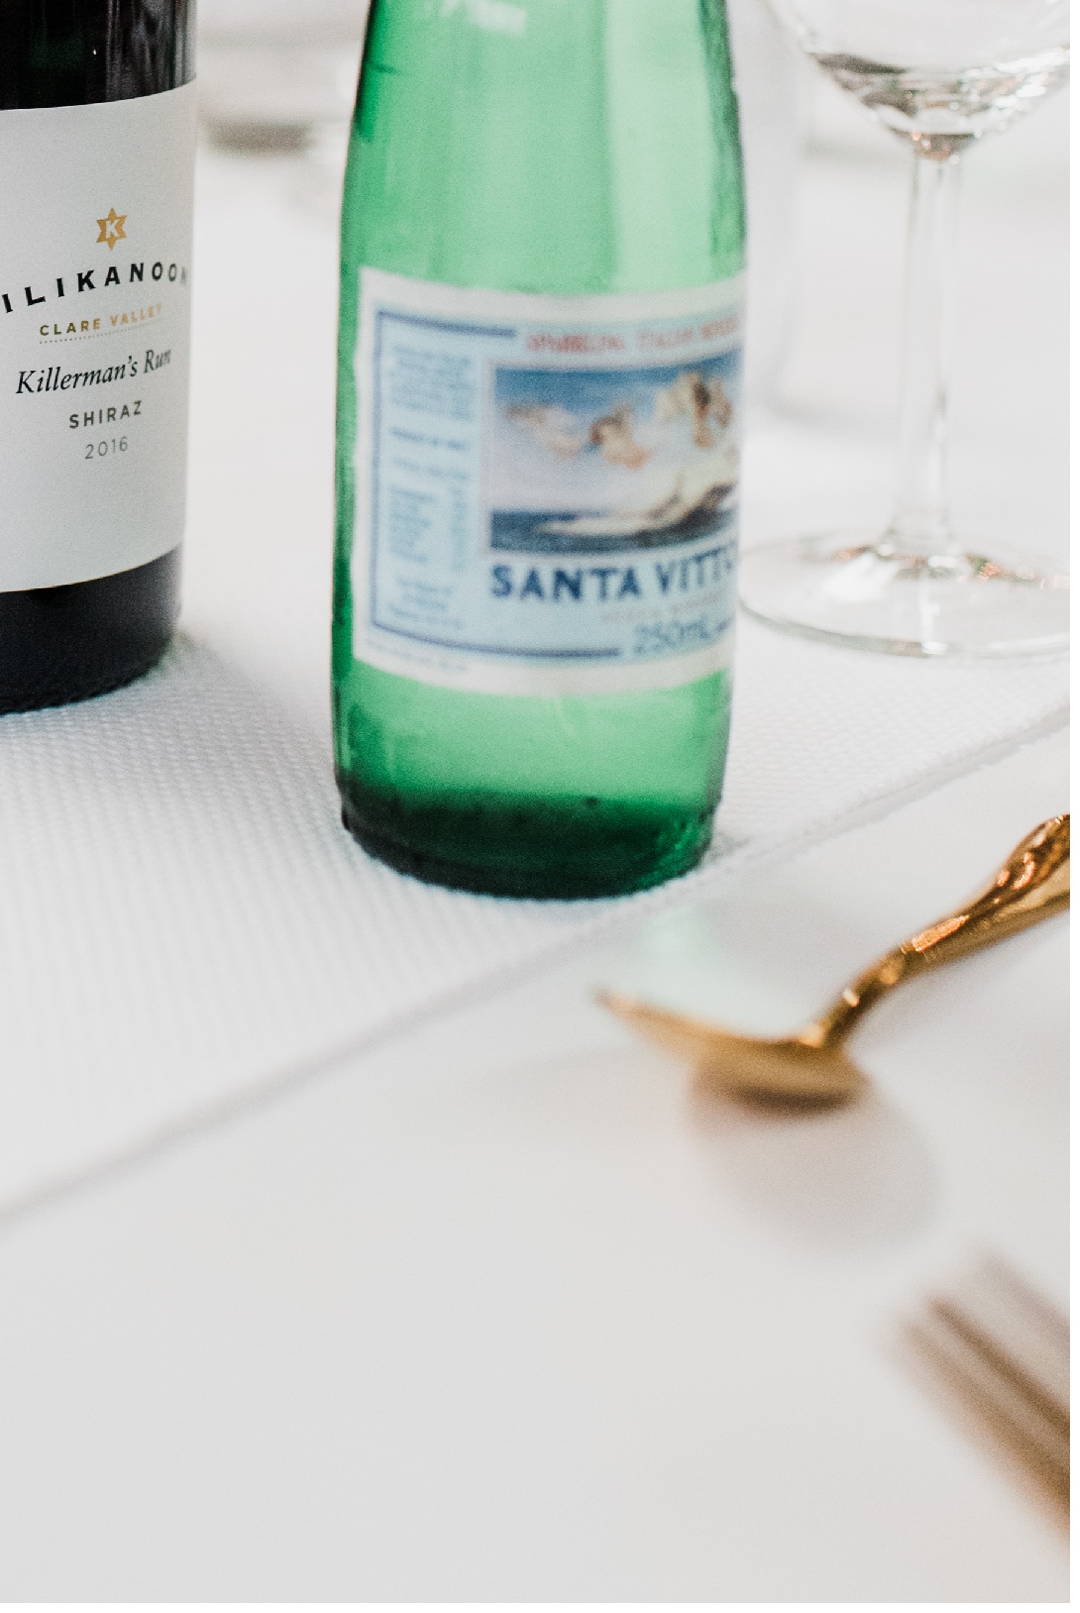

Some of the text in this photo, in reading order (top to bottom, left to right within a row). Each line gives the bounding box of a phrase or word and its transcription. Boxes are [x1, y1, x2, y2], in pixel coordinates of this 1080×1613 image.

[105, 218, 120, 239] K
[39, 303, 163, 336] CLARE VALLEY
[15, 349, 172, 395] Killerman's Run
[68, 399, 143, 429] SHIRAZ
[84, 436, 129, 460] 2016
[491, 564, 642, 602] SANTA
